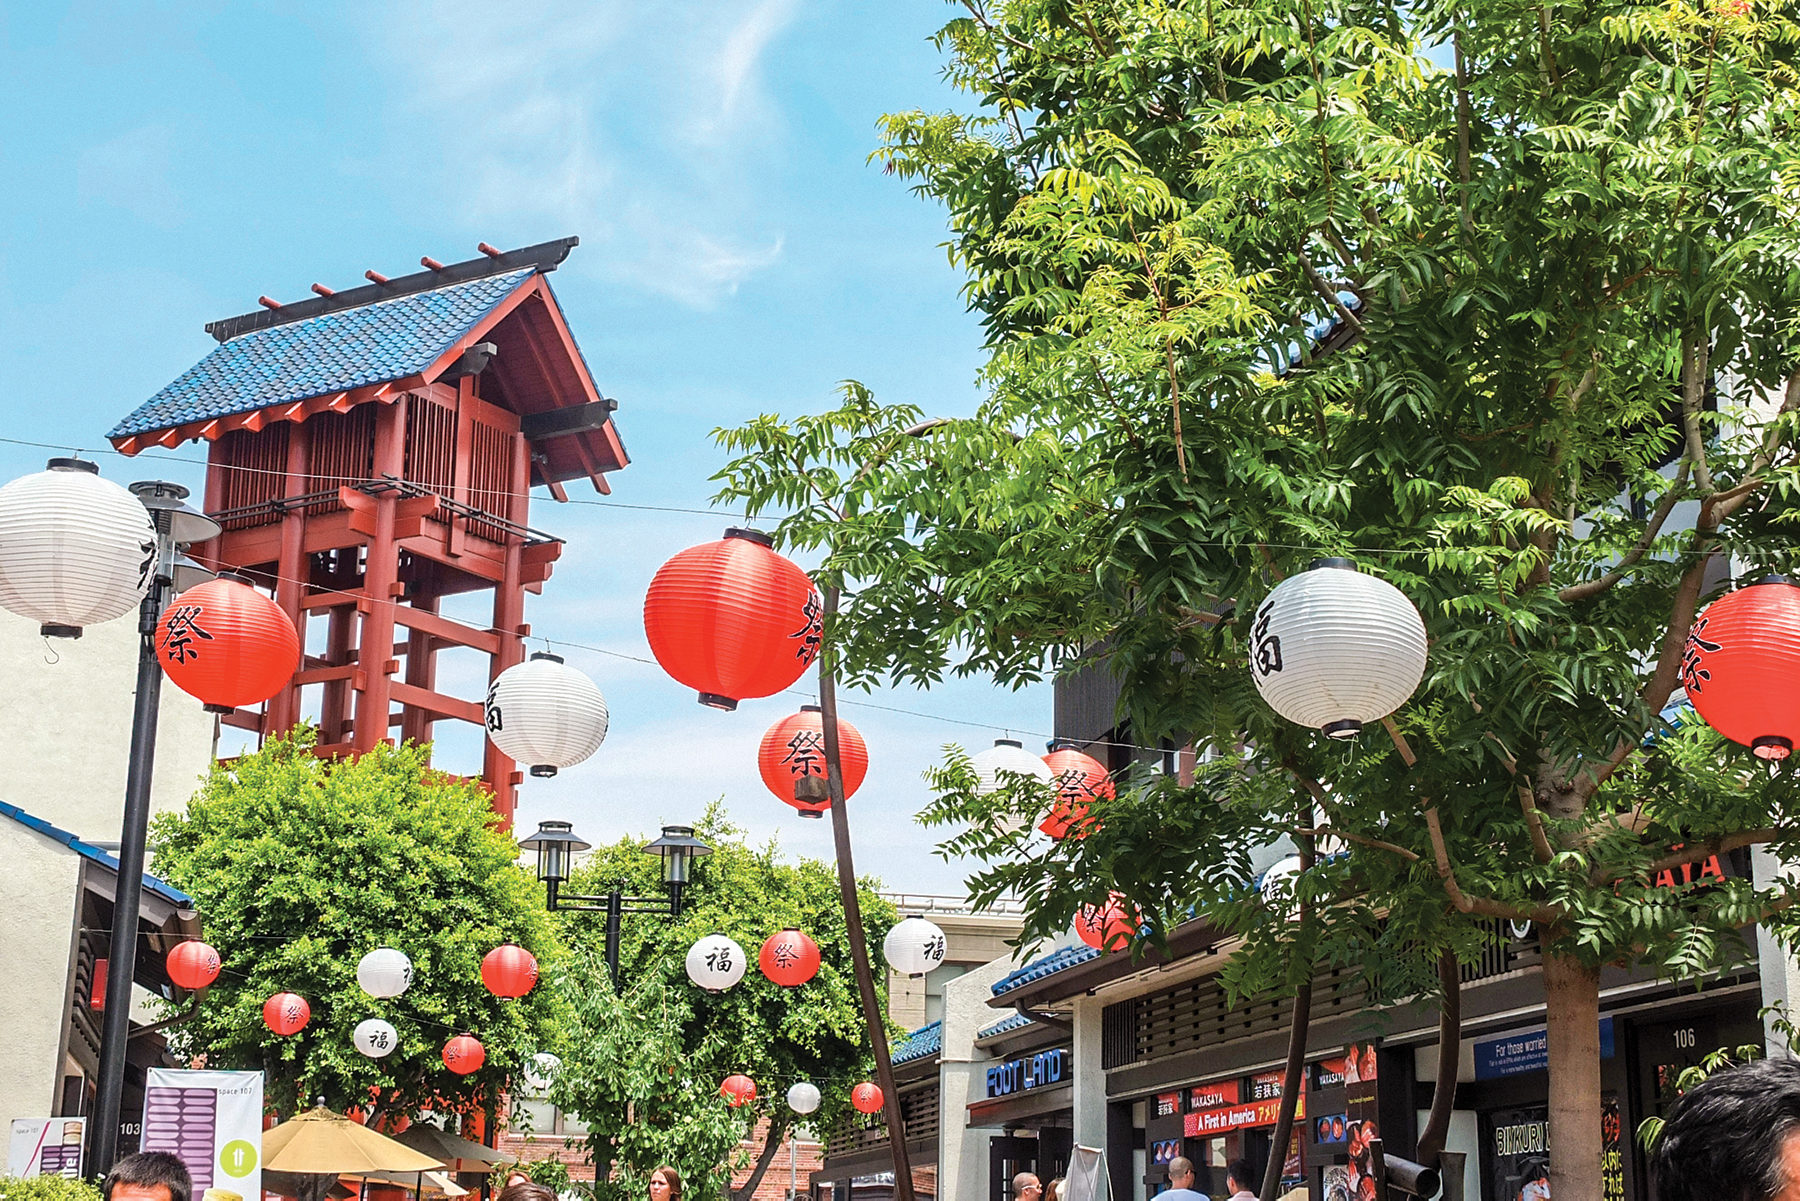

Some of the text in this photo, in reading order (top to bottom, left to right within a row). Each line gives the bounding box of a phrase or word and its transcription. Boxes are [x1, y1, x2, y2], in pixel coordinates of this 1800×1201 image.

[161, 605, 213, 665] 祭
[780, 731, 826, 775] 祭
[705, 946, 733, 972] 福
[773, 943, 799, 969] 祭
[923, 935, 944, 961] 福
[286, 1005, 304, 1024] 祭
[369, 1030, 389, 1050] 福
[1496, 1036, 1546, 1057] For those worried
[1673, 1028, 1695, 1048] 106
[987, 1049, 1061, 1097] FOOT LAND
[1191, 1093, 1223, 1108] WAKASAYA
[120, 1123, 140, 1135] 103
[1198, 1108, 1256, 1130] A First in America
